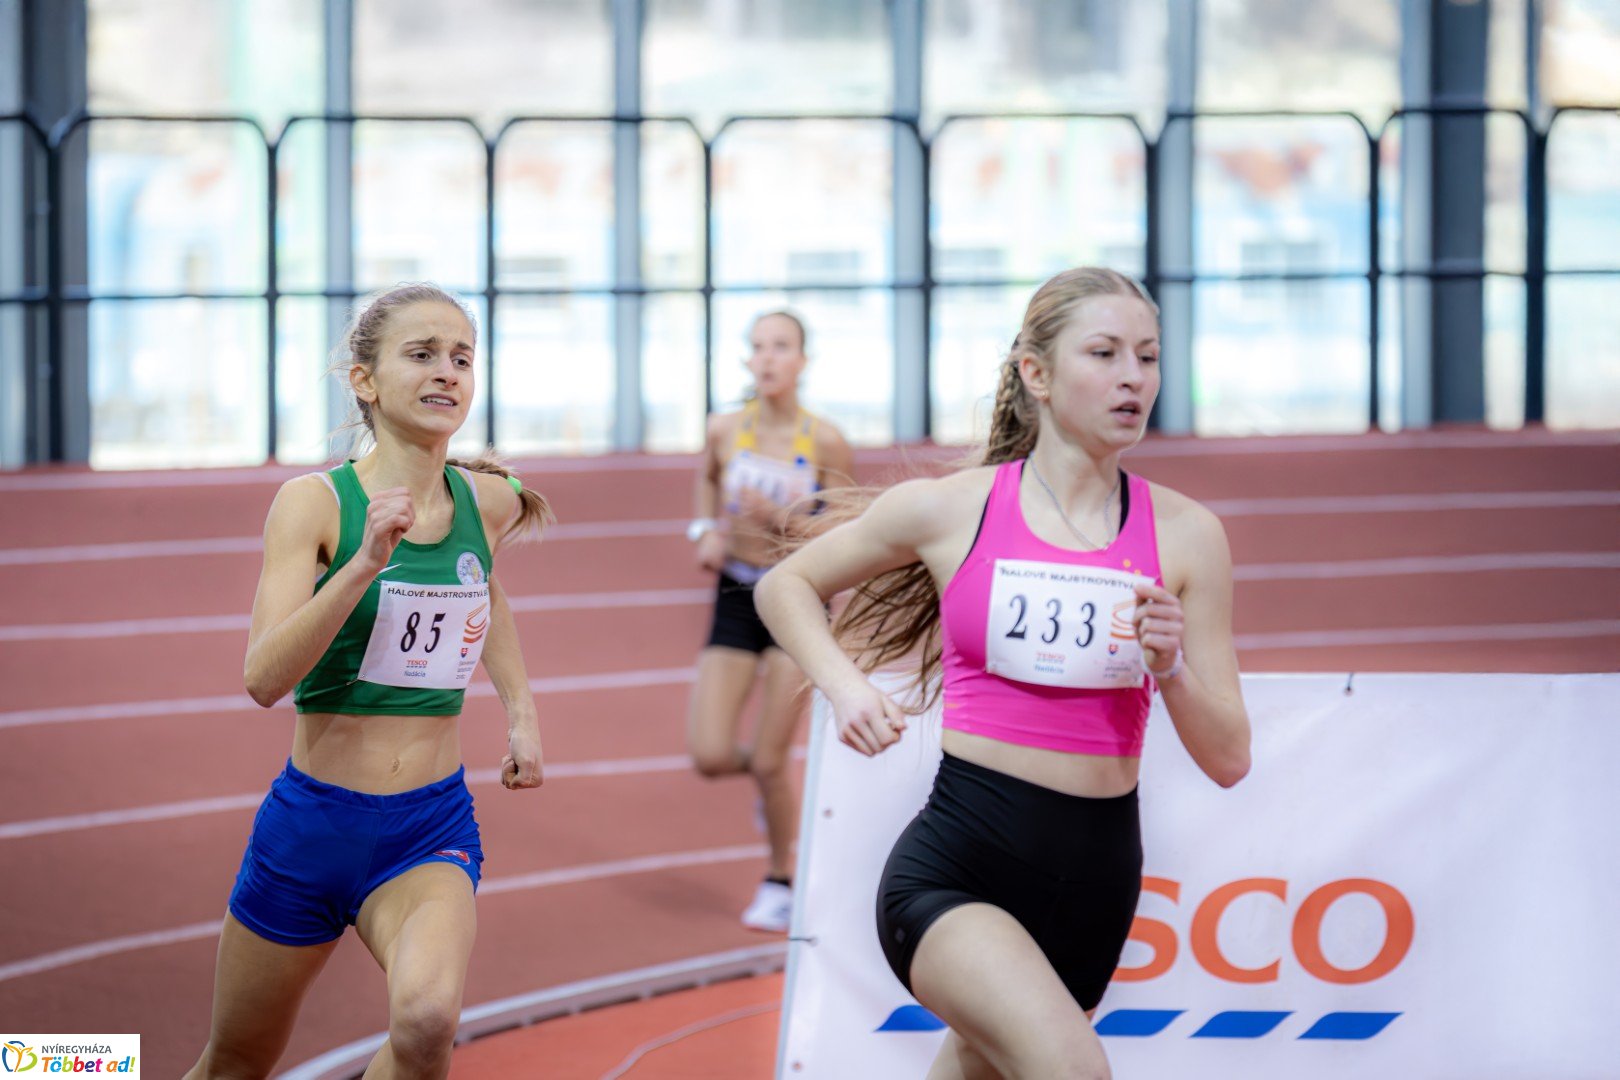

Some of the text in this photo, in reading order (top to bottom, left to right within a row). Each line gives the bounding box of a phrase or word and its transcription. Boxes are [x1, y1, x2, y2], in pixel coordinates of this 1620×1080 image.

[387, 587, 425, 598] HALOVÉ
[426, 589, 483, 599] MAJSTROVSTVÁ
[400, 611, 446, 653] 85
[1005, 594, 1096, 648] 233
[1109, 876, 1415, 985] SCO
